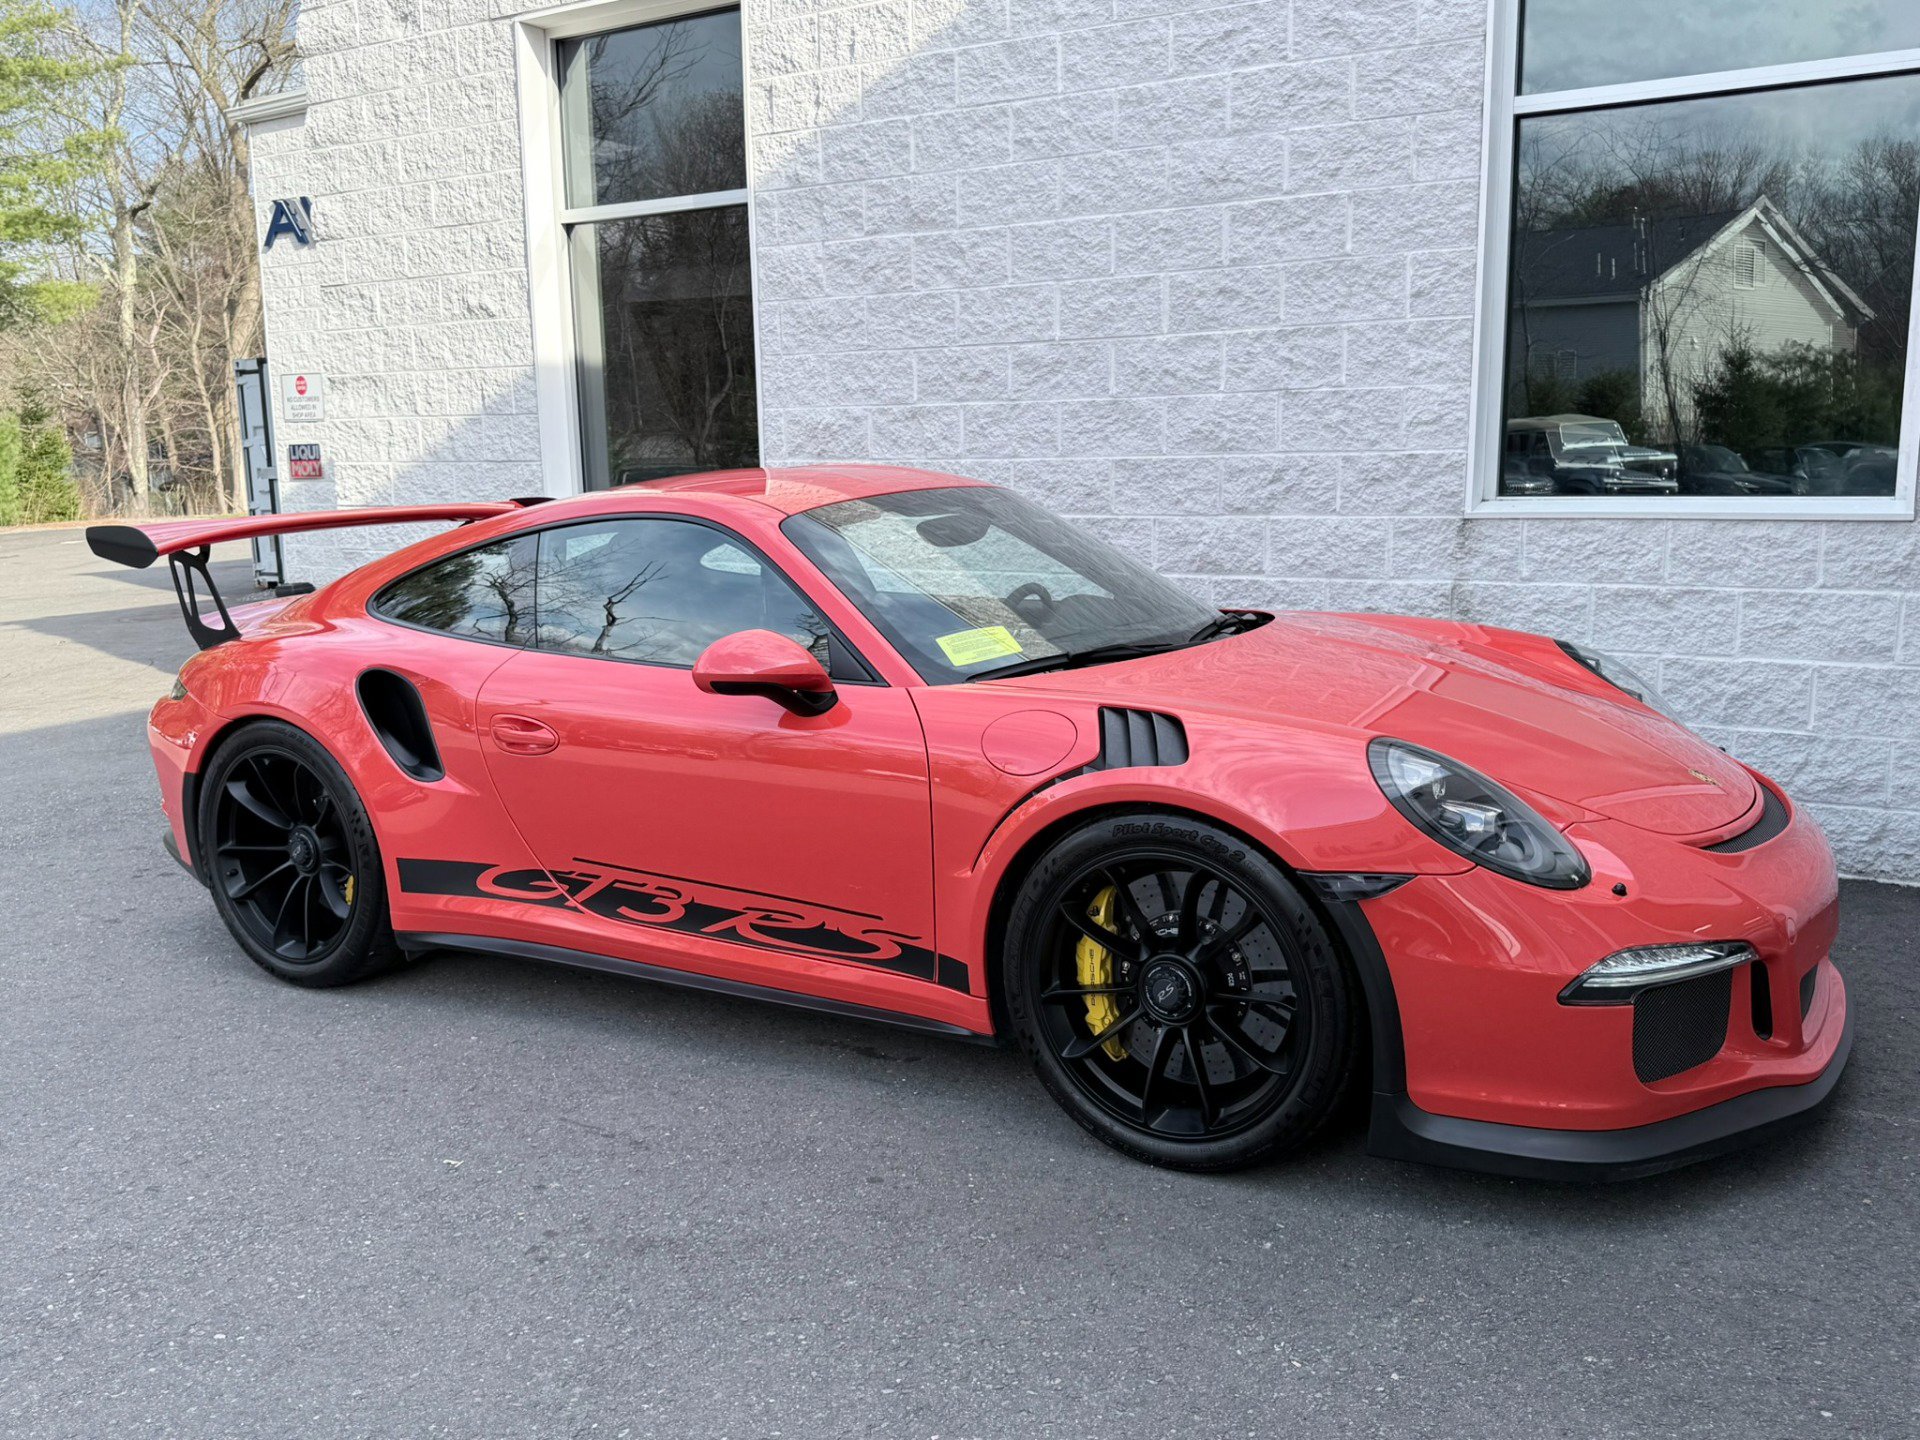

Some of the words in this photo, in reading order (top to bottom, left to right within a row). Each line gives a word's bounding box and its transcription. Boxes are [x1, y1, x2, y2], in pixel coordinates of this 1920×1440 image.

[290, 446, 320, 460] LIQUI
[291, 461, 321, 477] MOLY
[1112, 823, 1151, 837] Pilot
[1151, 823, 1198, 842] Sport
[1200, 835, 1229, 852] Cup
[1229, 850, 1246, 863] 2
[475, 864, 693, 924] GT3
[700, 906, 924, 960] RS
[1157, 982, 1174, 1003] RS
